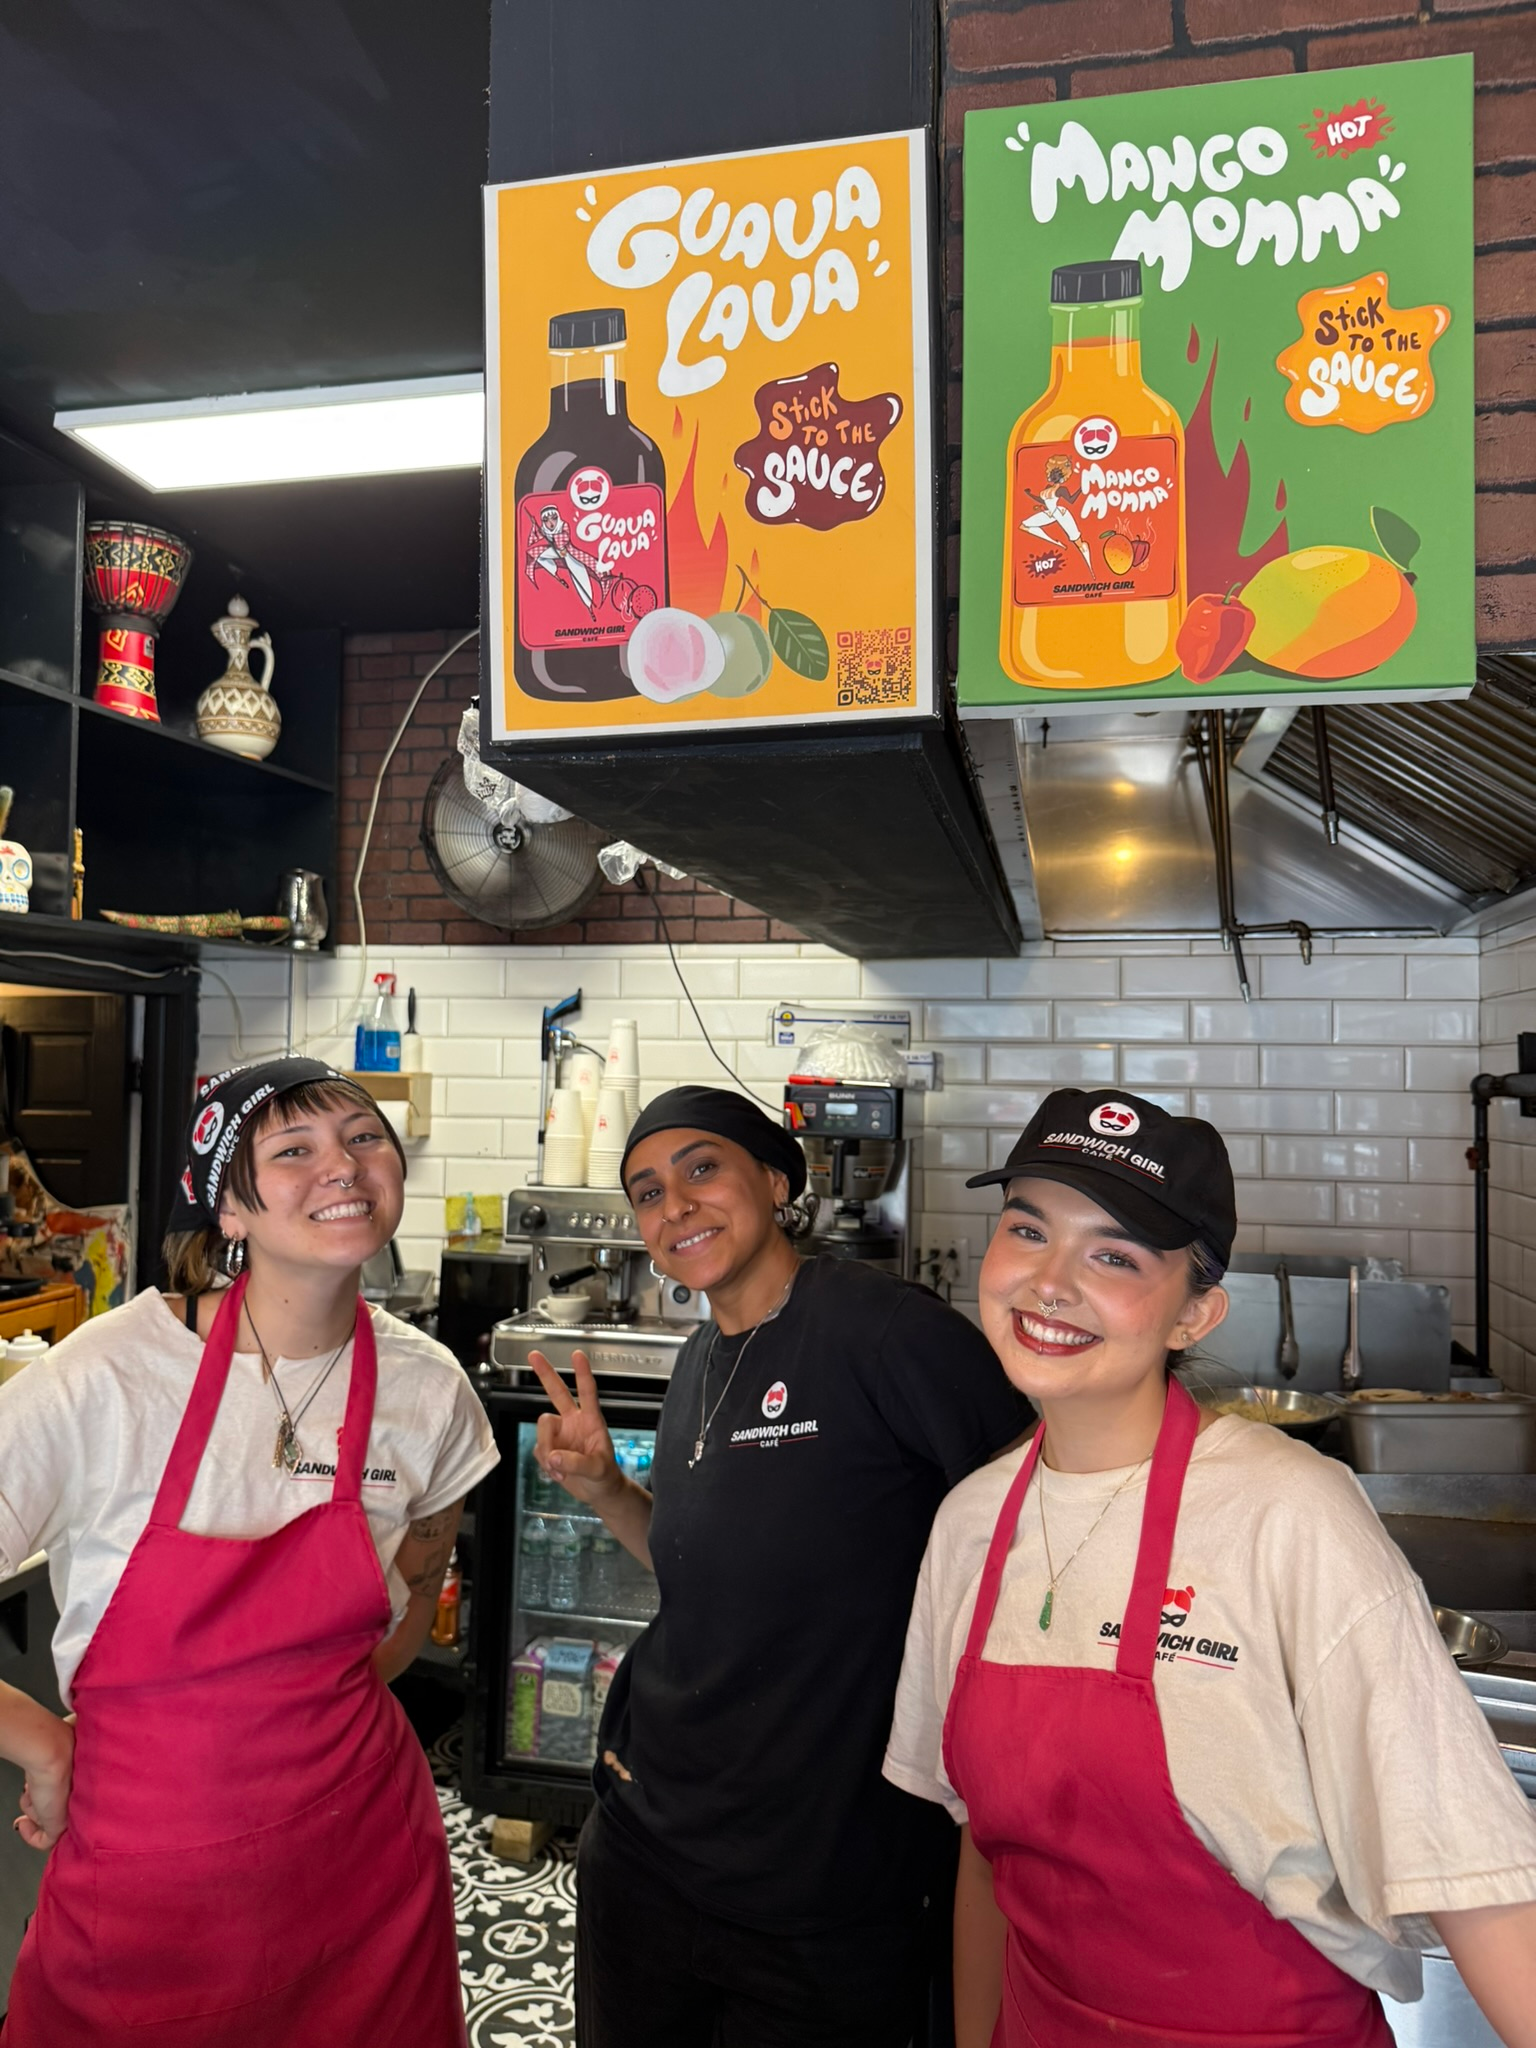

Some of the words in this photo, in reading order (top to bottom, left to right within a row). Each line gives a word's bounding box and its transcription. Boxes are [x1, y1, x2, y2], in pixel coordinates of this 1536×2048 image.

[1326, 115, 1373, 146] HOT
[1030, 121, 1288, 223] MANGO
[1109, 177, 1401, 292] MOMMA
[1348, 333, 1374, 352] TO
[1381, 328, 1421, 351] THE
[1300, 350, 1419, 417] SAUCE
[801, 425, 828, 446] TO
[835, 420, 876, 444] THE
[756, 445, 874, 517] SAUCE
[1081, 463, 1160, 495] MANGO
[1081, 486, 1169, 520] MOMMA
[1035, 557, 1057, 573] HOT
[1053, 582, 1111, 593] SANDWICH
[1112, 580, 1135, 590] GIRL
[555, 627, 605, 637] SANDWICH
[606, 625, 625, 633] GIRL
[207, 1113, 242, 1207] SANDWICH
[242, 1083, 275, 1114] GIRL
[1043, 1132, 1131, 1159] SANDWICH
[1130, 1153, 1165, 1179] GIRL
[731, 1424, 788, 1442] SANDWICH
[790, 1420, 818, 1435] GIRL
[760, 1438, 779, 1448] CAFÉ
[370, 1469, 397, 1481] GIRL
[1100, 1622, 1195, 1652] SAICH
[1196, 1638, 1239, 1662] GIRL
[1154, 1651, 1177, 1663] AFÉ
